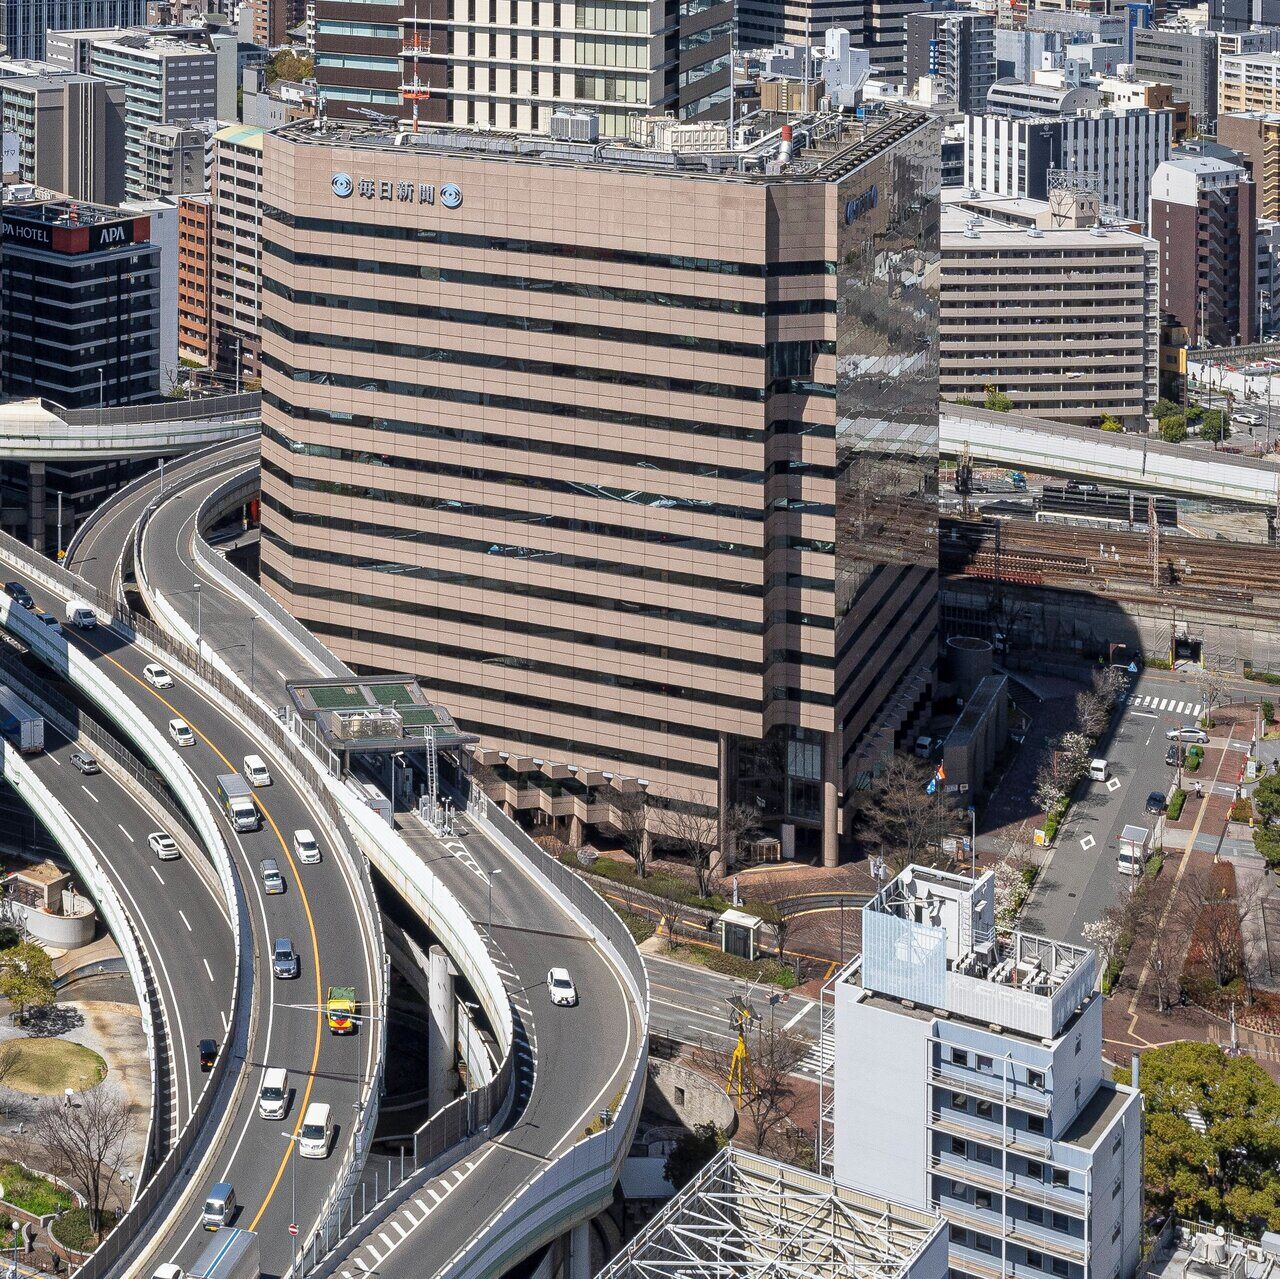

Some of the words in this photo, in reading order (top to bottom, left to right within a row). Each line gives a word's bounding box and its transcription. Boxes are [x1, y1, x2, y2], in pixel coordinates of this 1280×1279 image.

[357, 180, 435, 206] 毎日新聞
[3, 224, 15, 236] PA
[16, 226, 50, 243] HOTEL
[100, 226, 125, 244] APA
